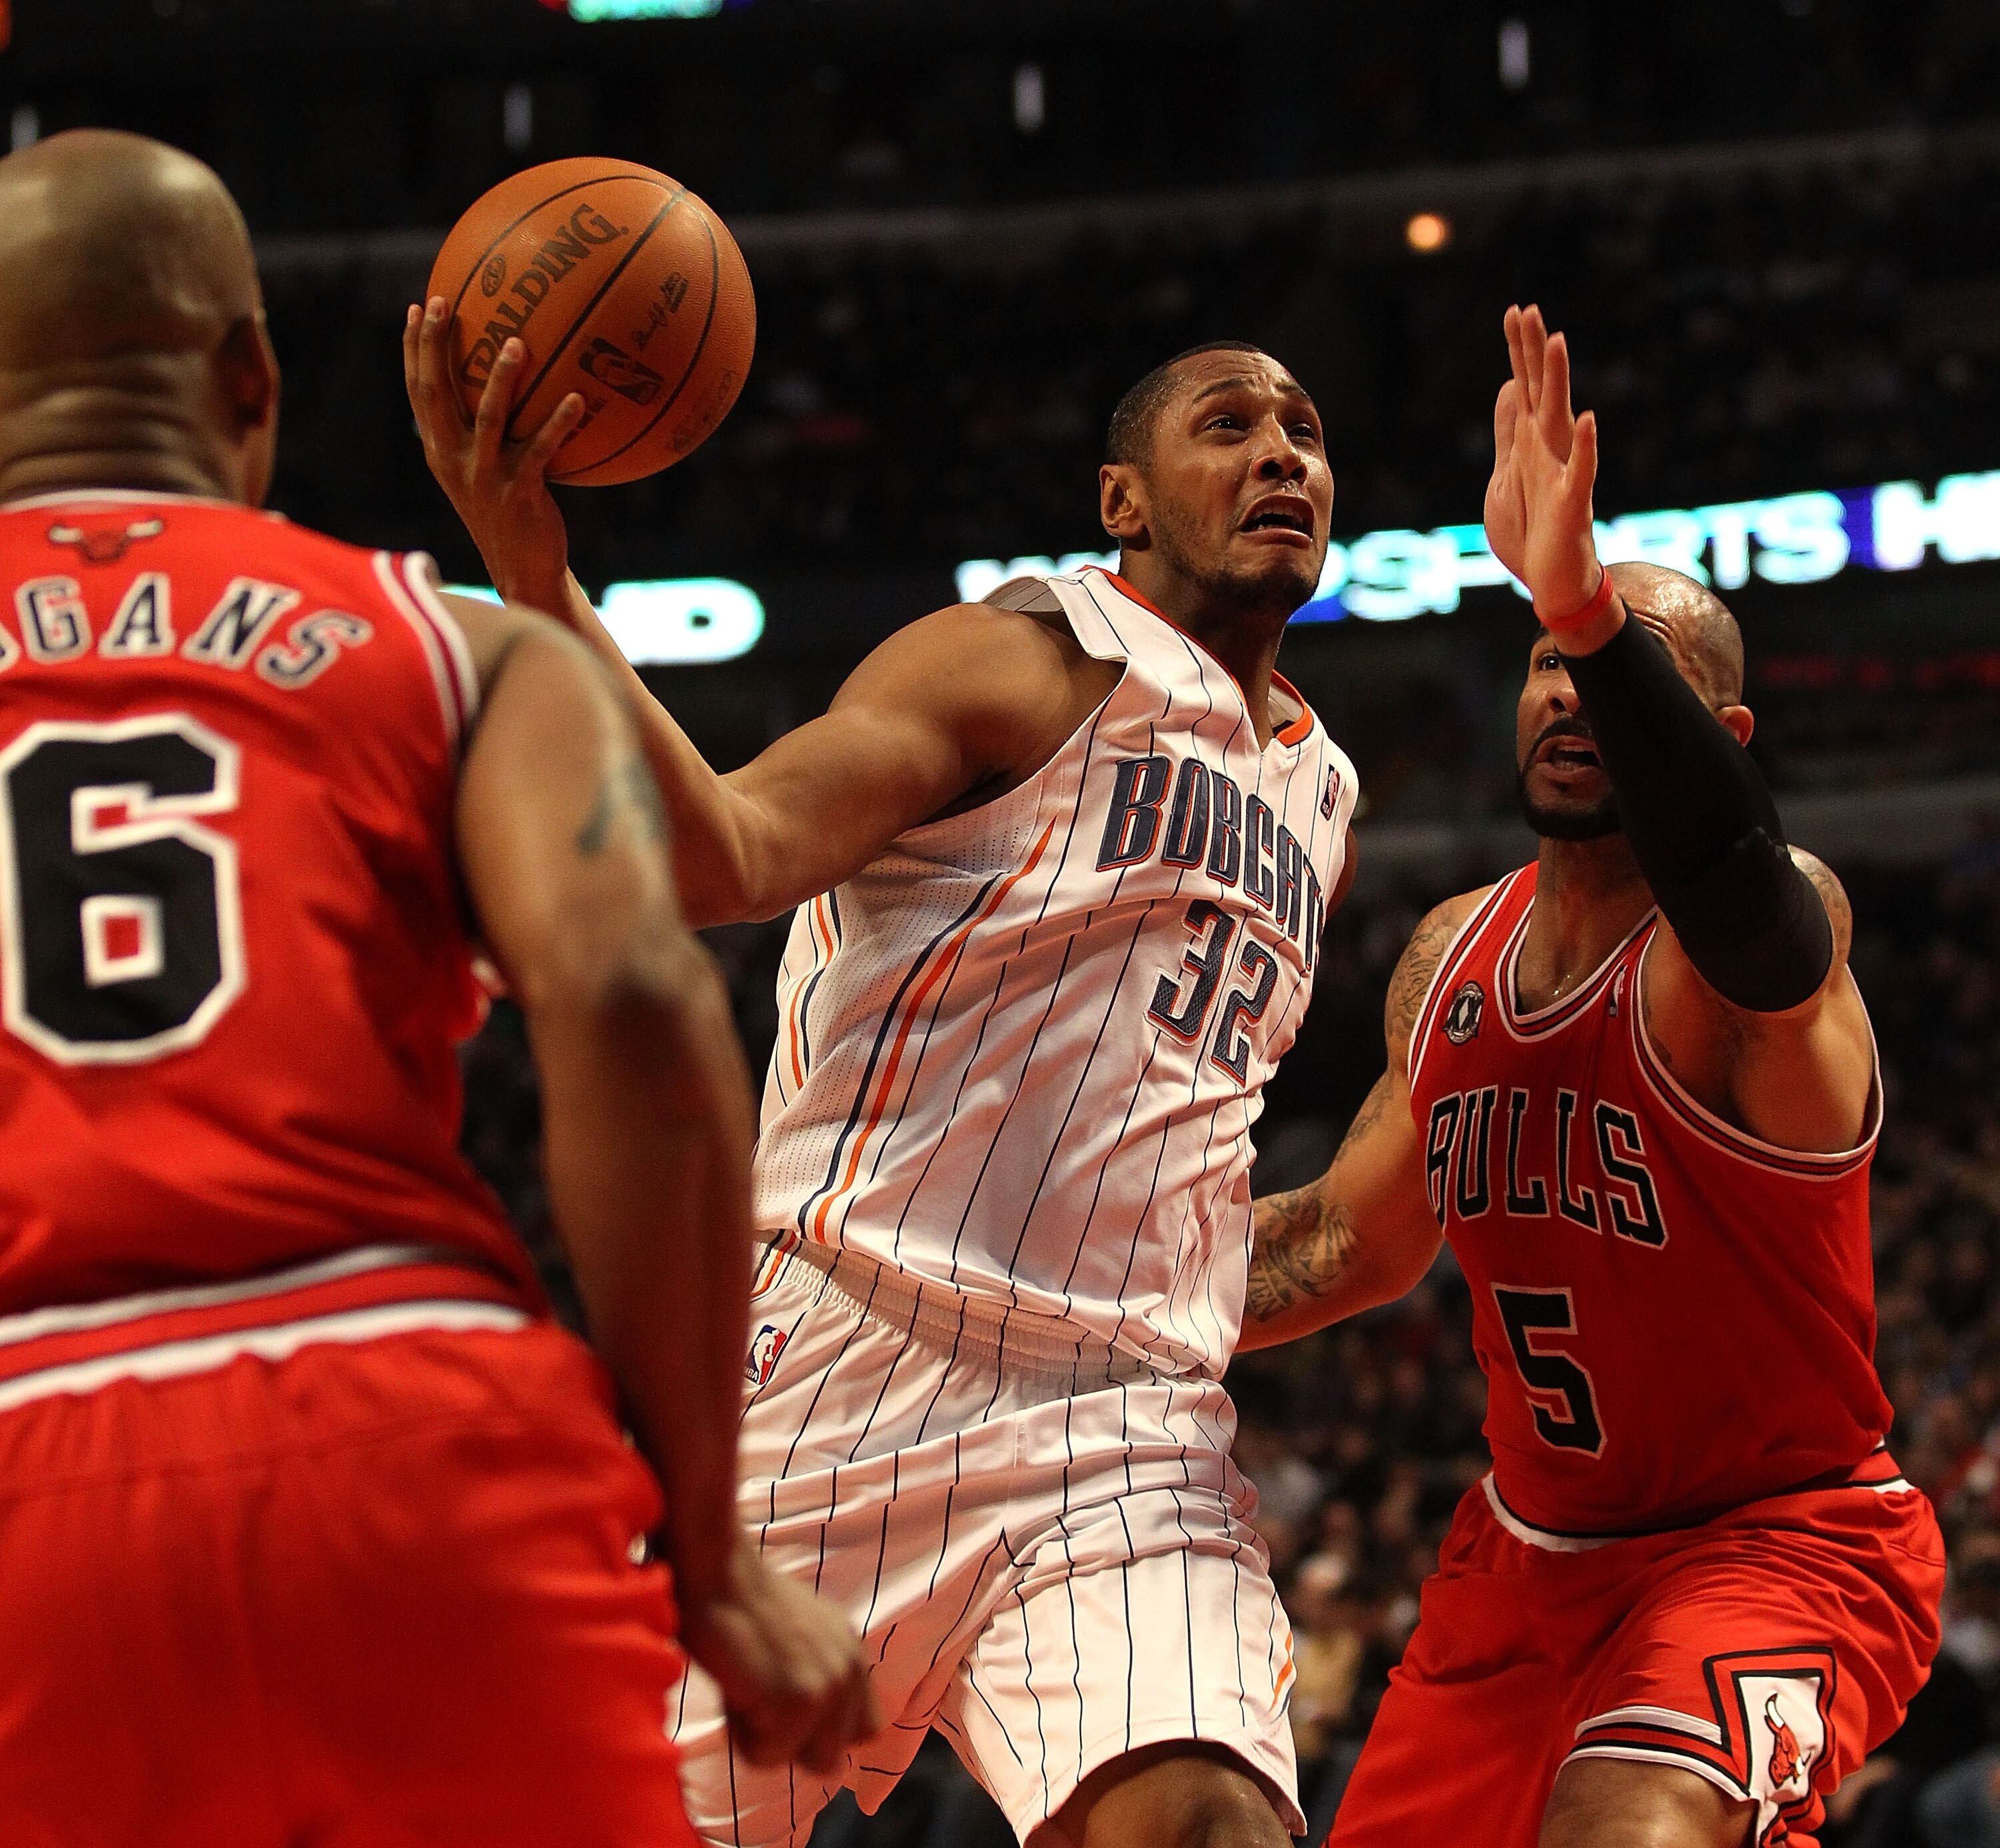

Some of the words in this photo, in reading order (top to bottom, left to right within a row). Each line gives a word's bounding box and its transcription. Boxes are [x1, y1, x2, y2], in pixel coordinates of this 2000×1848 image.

[0, 571, 375, 691] GANS
[1339, 490, 1851, 621] SPRTS
[1143, 898, 1279, 1089] 32
[1425, 1084, 1669, 1251] BULLS
[1491, 1281, 1608, 1461] 5
